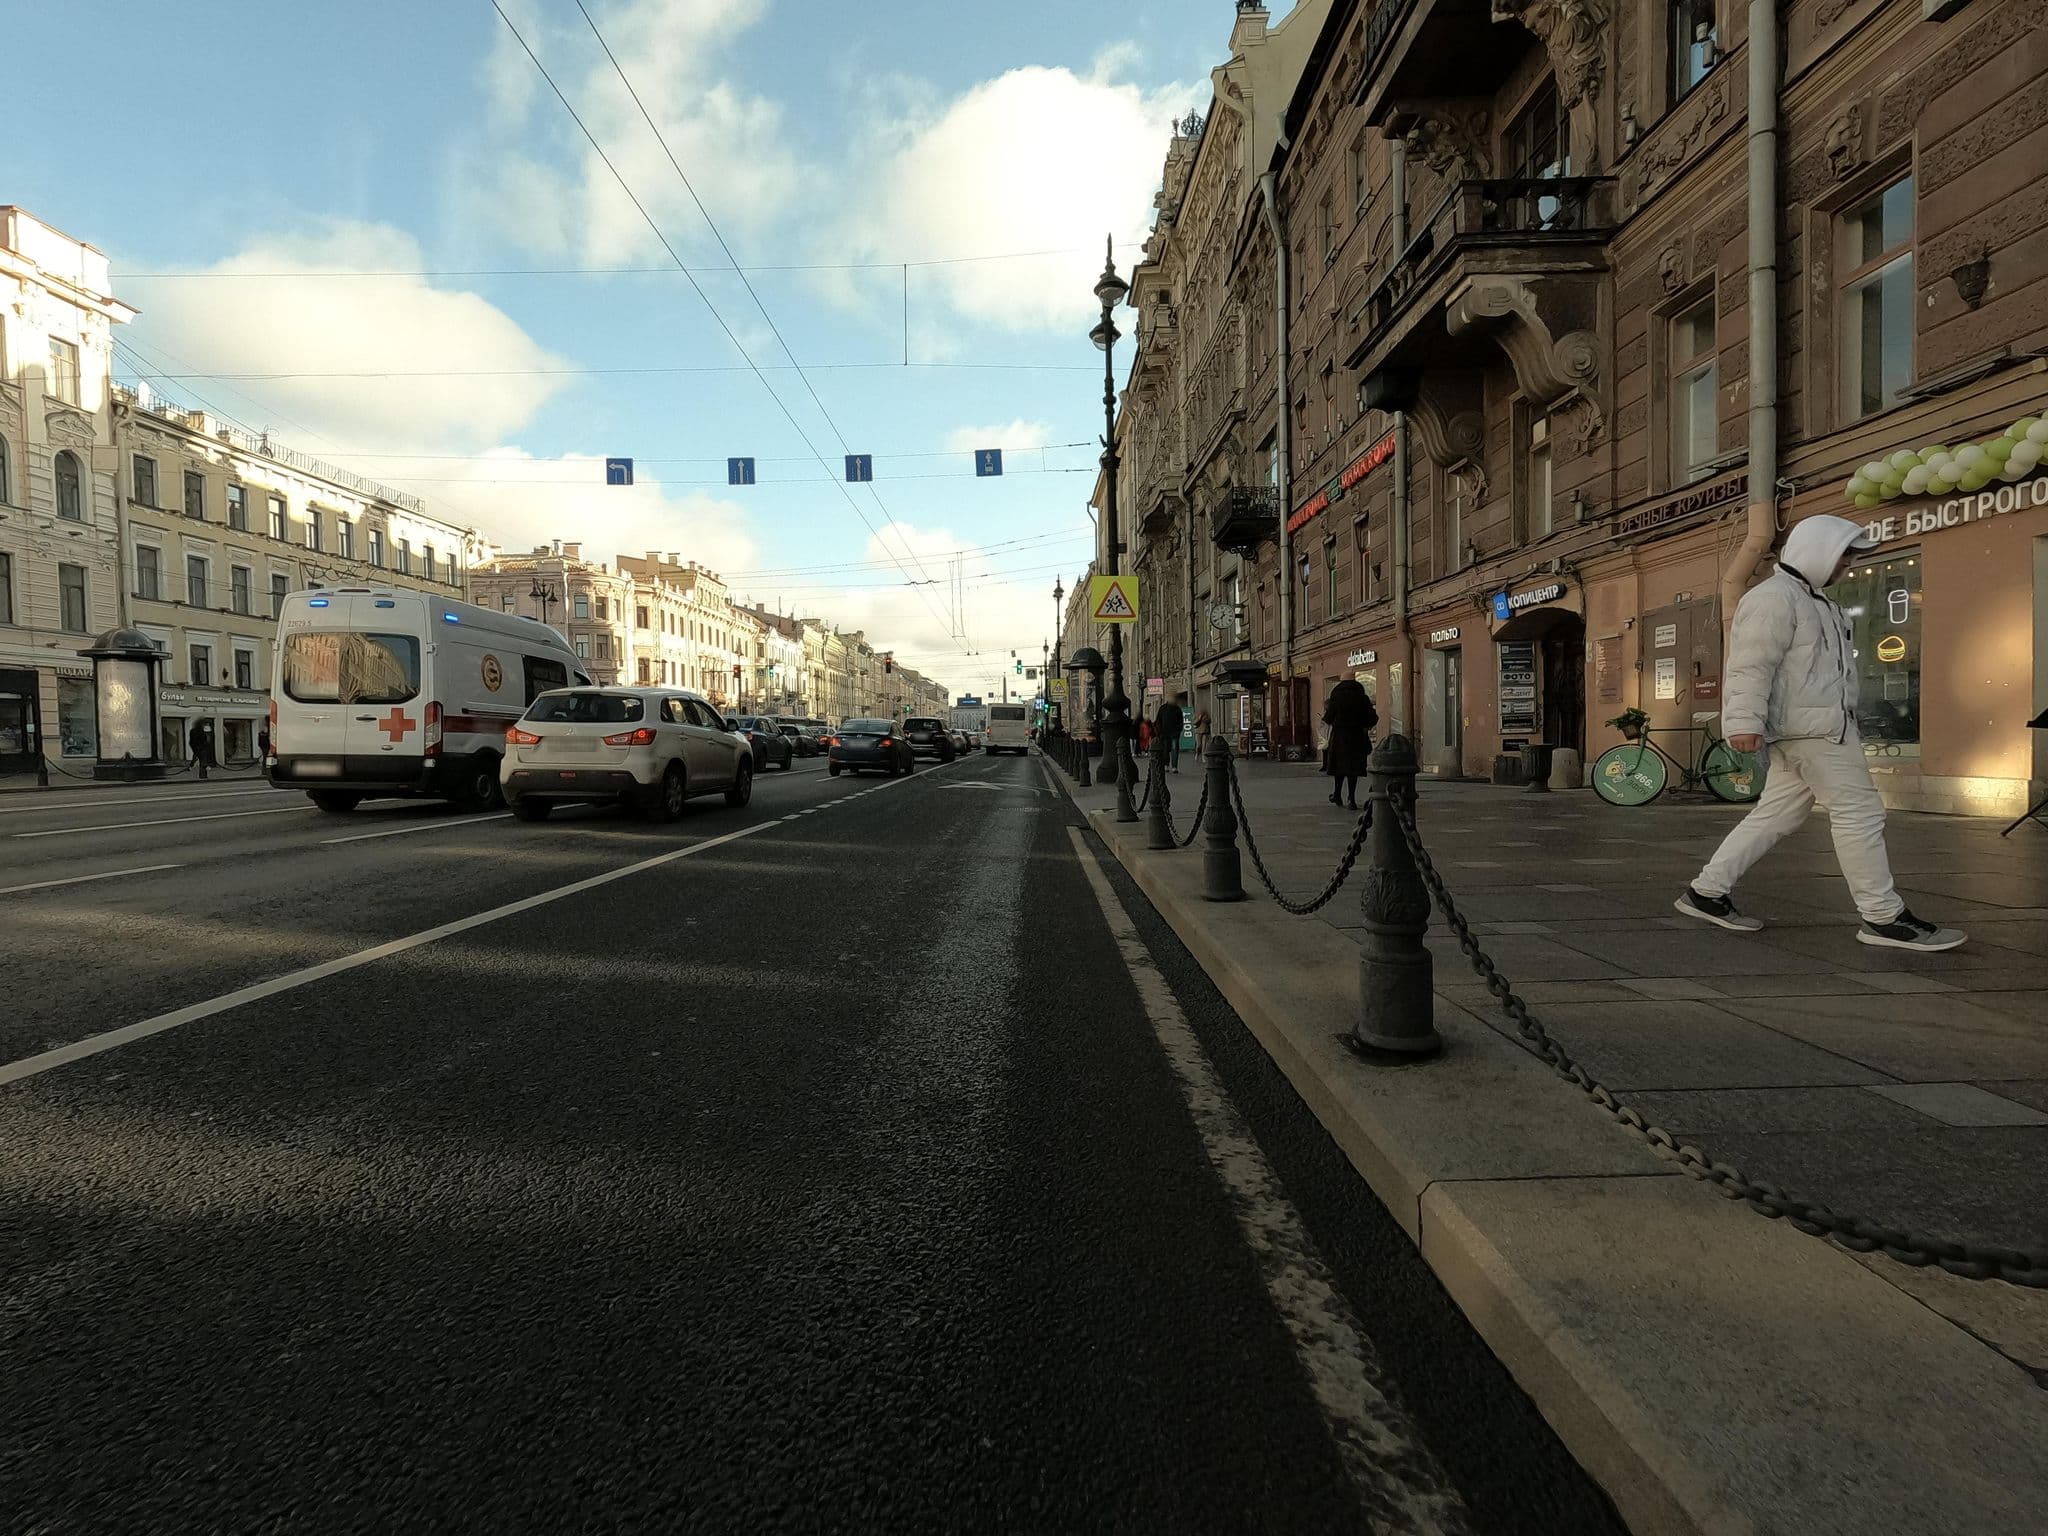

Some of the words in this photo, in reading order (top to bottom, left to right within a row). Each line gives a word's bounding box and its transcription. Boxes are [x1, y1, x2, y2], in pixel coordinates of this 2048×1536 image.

[1620, 505, 1671, 532] РЕЧНЫЕ
[1675, 479, 1741, 515] КРУИЗЫ
[1906, 477, 2048, 536] БЫСТРОГО
[1508, 584, 1559, 609] КОПИЦЕНТР
